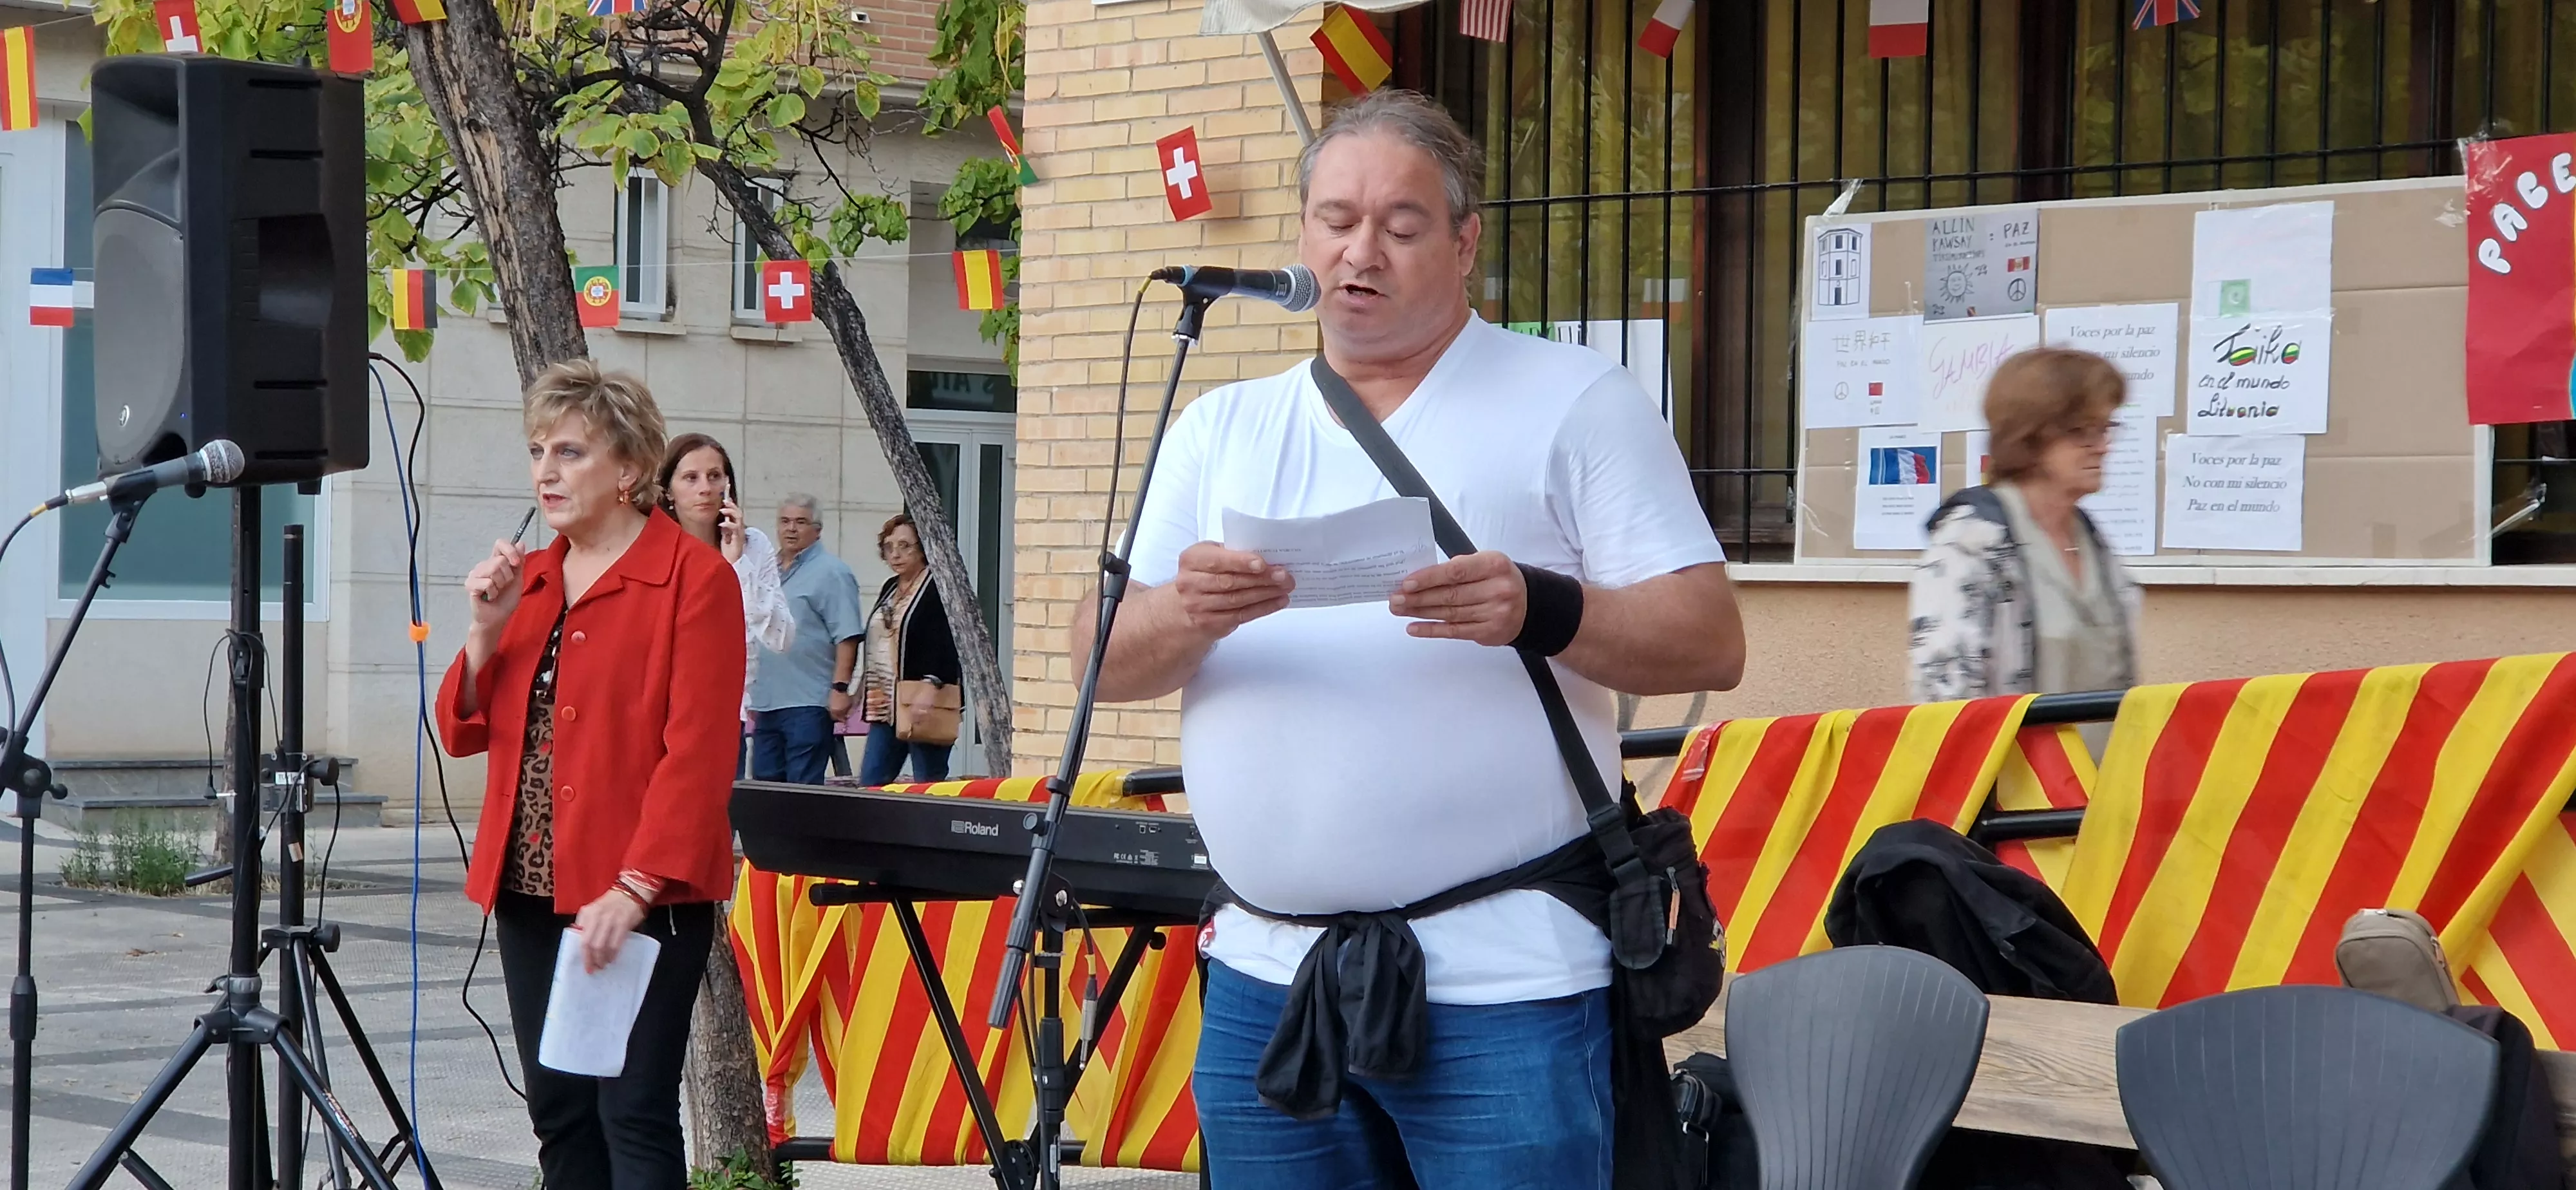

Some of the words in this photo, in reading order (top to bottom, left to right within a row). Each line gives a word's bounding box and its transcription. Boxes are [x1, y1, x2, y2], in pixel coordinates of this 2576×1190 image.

[1933, 216, 1975, 235] ALLIN
[1933, 235, 1972, 252] KAWSAY
[2003, 221, 2030, 238] PAZ
[2070, 326, 2101, 337] Voces
[2102, 328, 2124, 339] por
[2125, 324, 2134, 335] la
[2136, 326, 2155, 338] paz
[2103, 347, 2119, 359] mi
[2120, 345, 2161, 358] silencio
[2124, 368, 2154, 381] undo
[2198, 374, 2215, 388] en
[2235, 375, 2290, 389] mundo
[2197, 393, 2280, 418] Lituania
[2192, 453, 2224, 464] Voces
[2224, 456, 2248, 468] por
[2248, 453, 2259, 465] la
[2260, 457, 2282, 468] paz
[2183, 475, 2201, 487] No
[2202, 479, 2224, 488] con
[2226, 477, 2243, 489] mi
[2244, 477, 2287, 489] silencio
[2186, 498, 2208, 511] Paz
[2210, 502, 2225, 511] en
[2226, 499, 2239, 511] el
[2239, 500, 2280, 512] mundo
[964, 821, 999, 836] Roland
